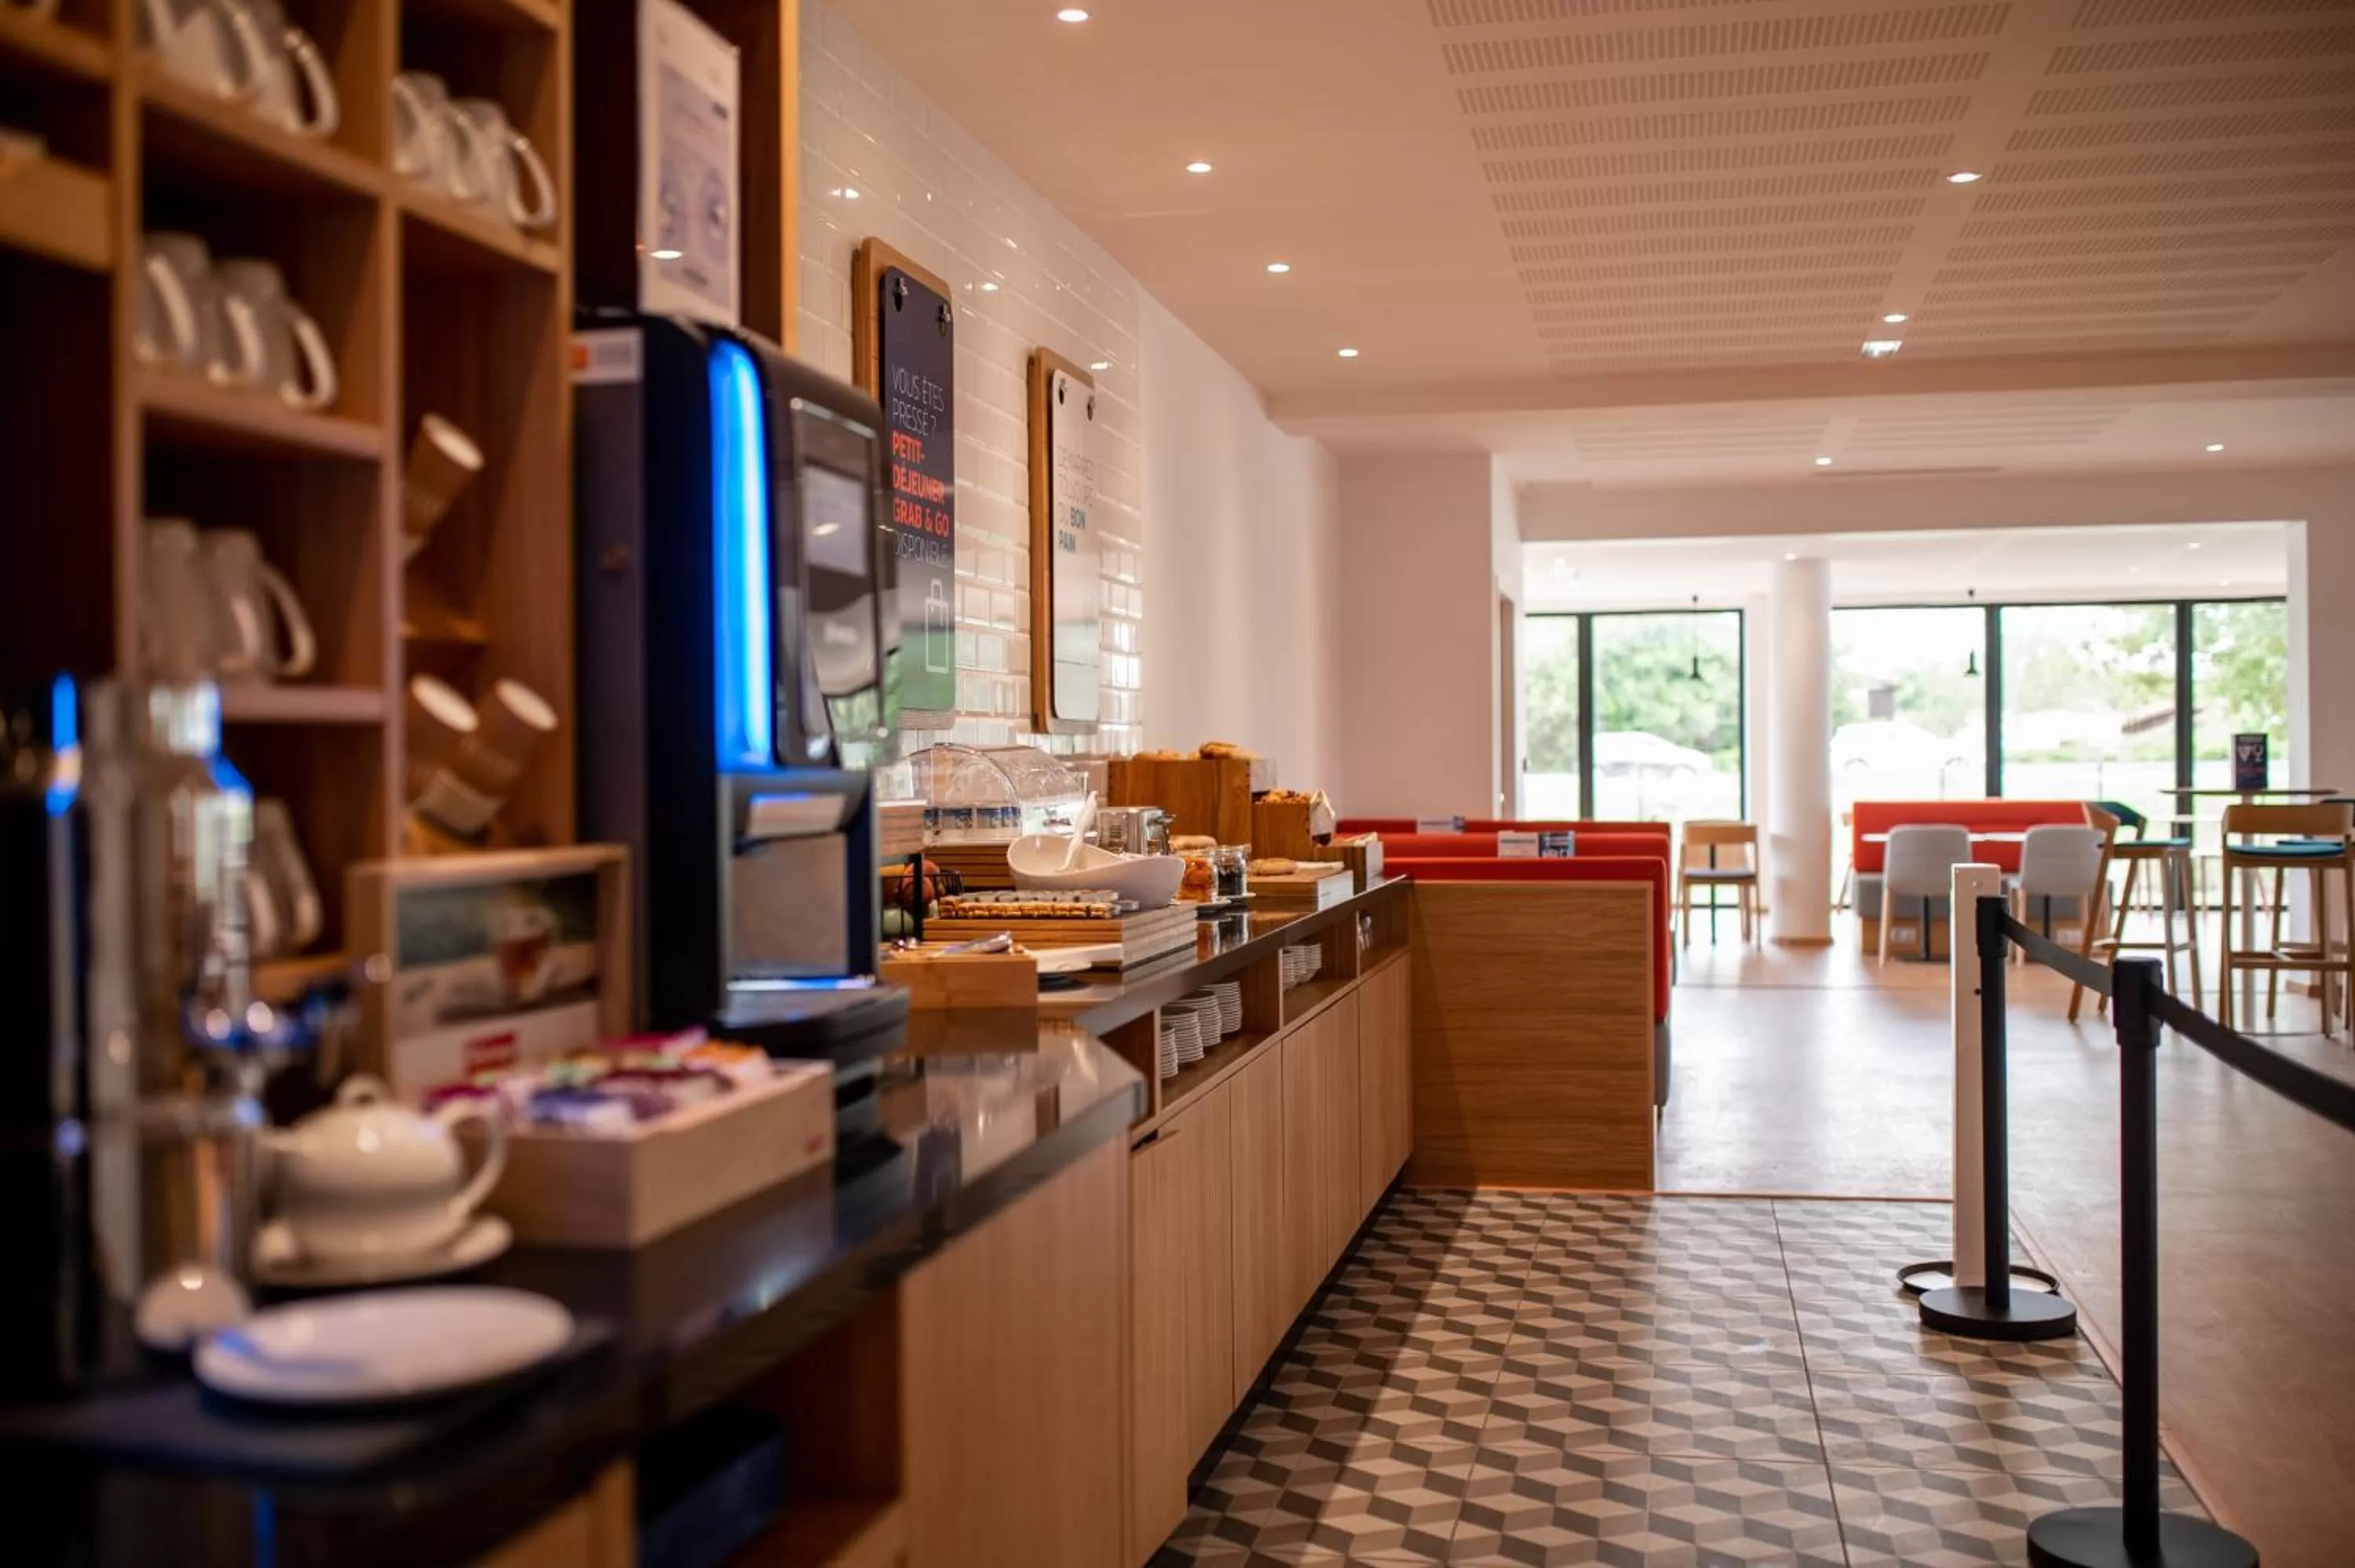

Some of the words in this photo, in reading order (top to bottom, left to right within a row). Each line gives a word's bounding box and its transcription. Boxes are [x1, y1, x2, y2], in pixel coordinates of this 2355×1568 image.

[892, 364, 919, 400] VOUS
[923, 376, 944, 413] ÊTES
[893, 398, 929, 436] PRESSÉ
[893, 429, 926, 465] PETIT-
[893, 460, 946, 504] DÉJEUNER
[893, 497, 922, 529] GRAB
[925, 508, 933, 533] &
[935, 511, 949, 538] GO
